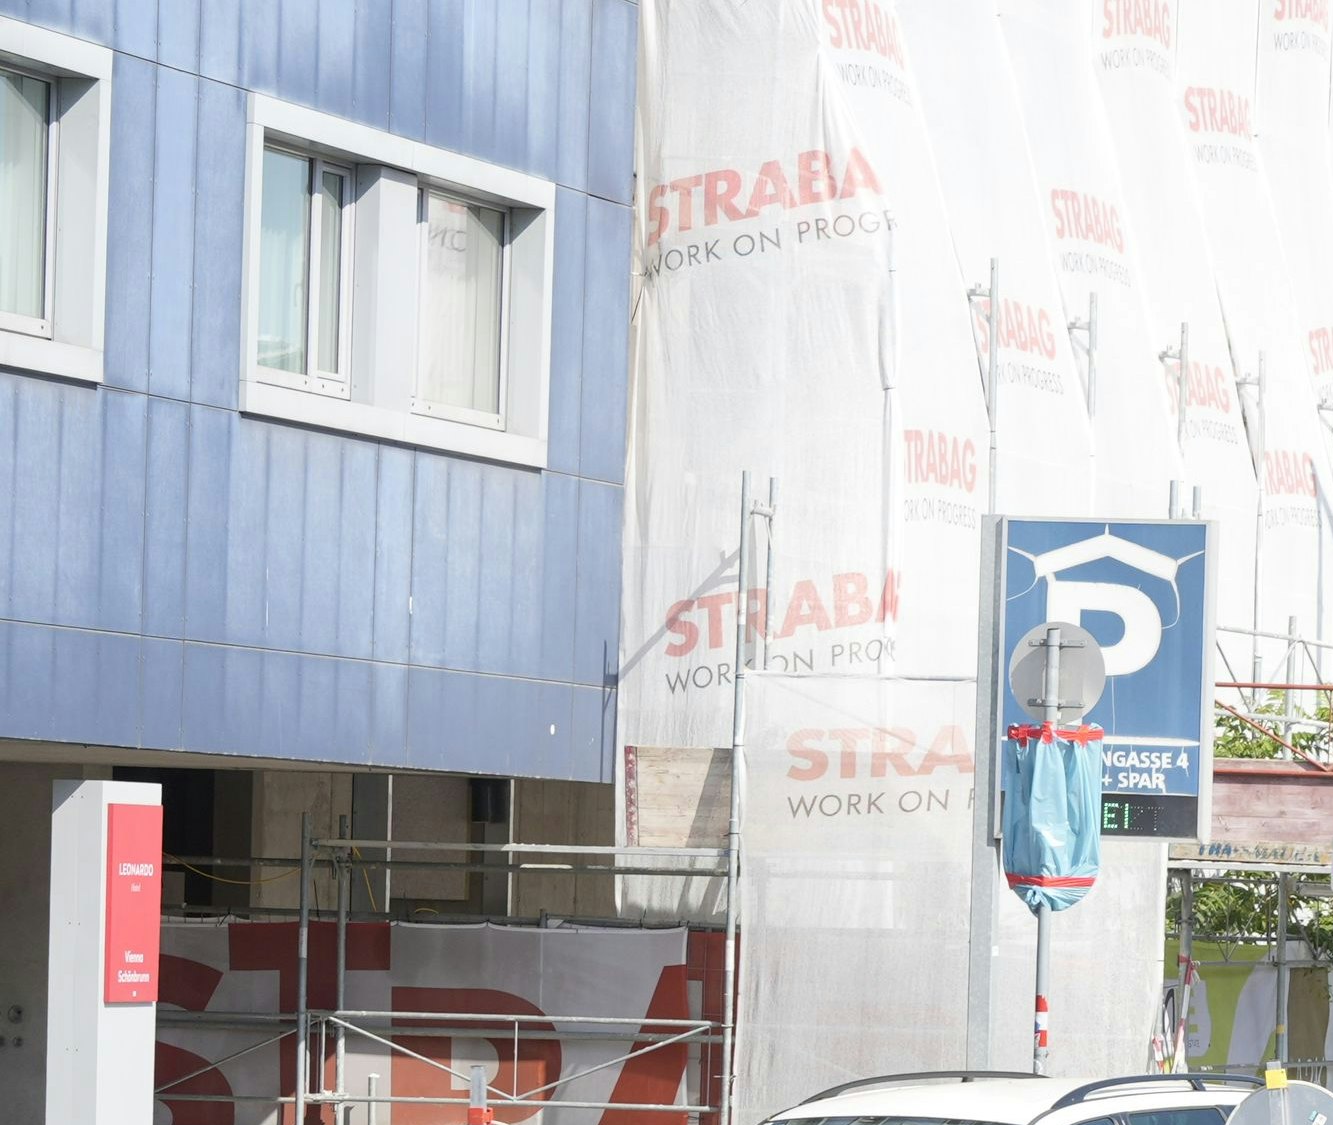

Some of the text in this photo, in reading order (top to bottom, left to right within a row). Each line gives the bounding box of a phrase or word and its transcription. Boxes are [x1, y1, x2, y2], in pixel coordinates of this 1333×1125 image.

[1050, 188, 1124, 254] STRABAG
[733, 227, 782, 257] ON
[1176, 752, 1189, 768] 4
[1117, 772, 1166, 789] SPAR
[787, 793, 884, 819] WORK
[899, 789, 950, 812] ON
[118, 863, 154, 877] LEONARDO
